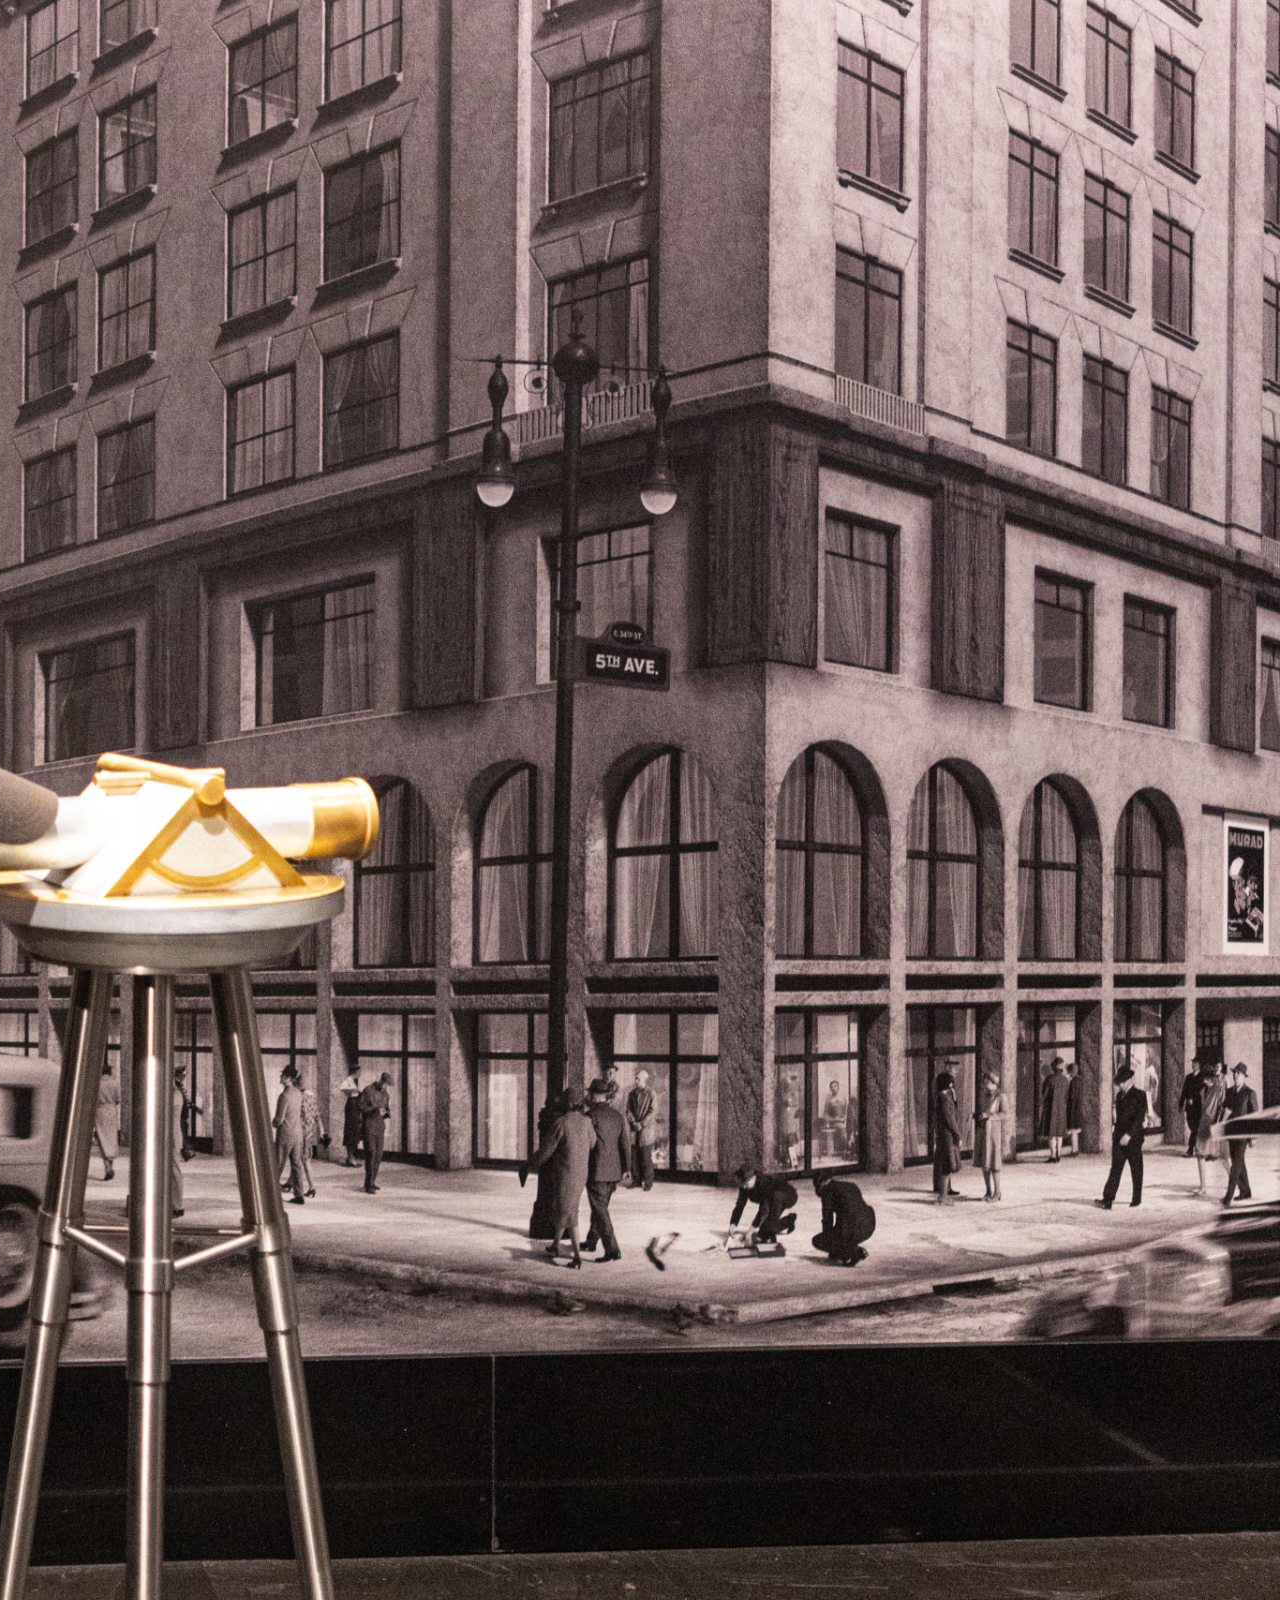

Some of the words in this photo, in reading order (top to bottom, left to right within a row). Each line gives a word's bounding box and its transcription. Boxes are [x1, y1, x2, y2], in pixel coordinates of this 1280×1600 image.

[595, 653, 620, 669] 5TH
[624, 657, 659, 675] AVE.
[1229, 831, 1263, 849] MURAD
